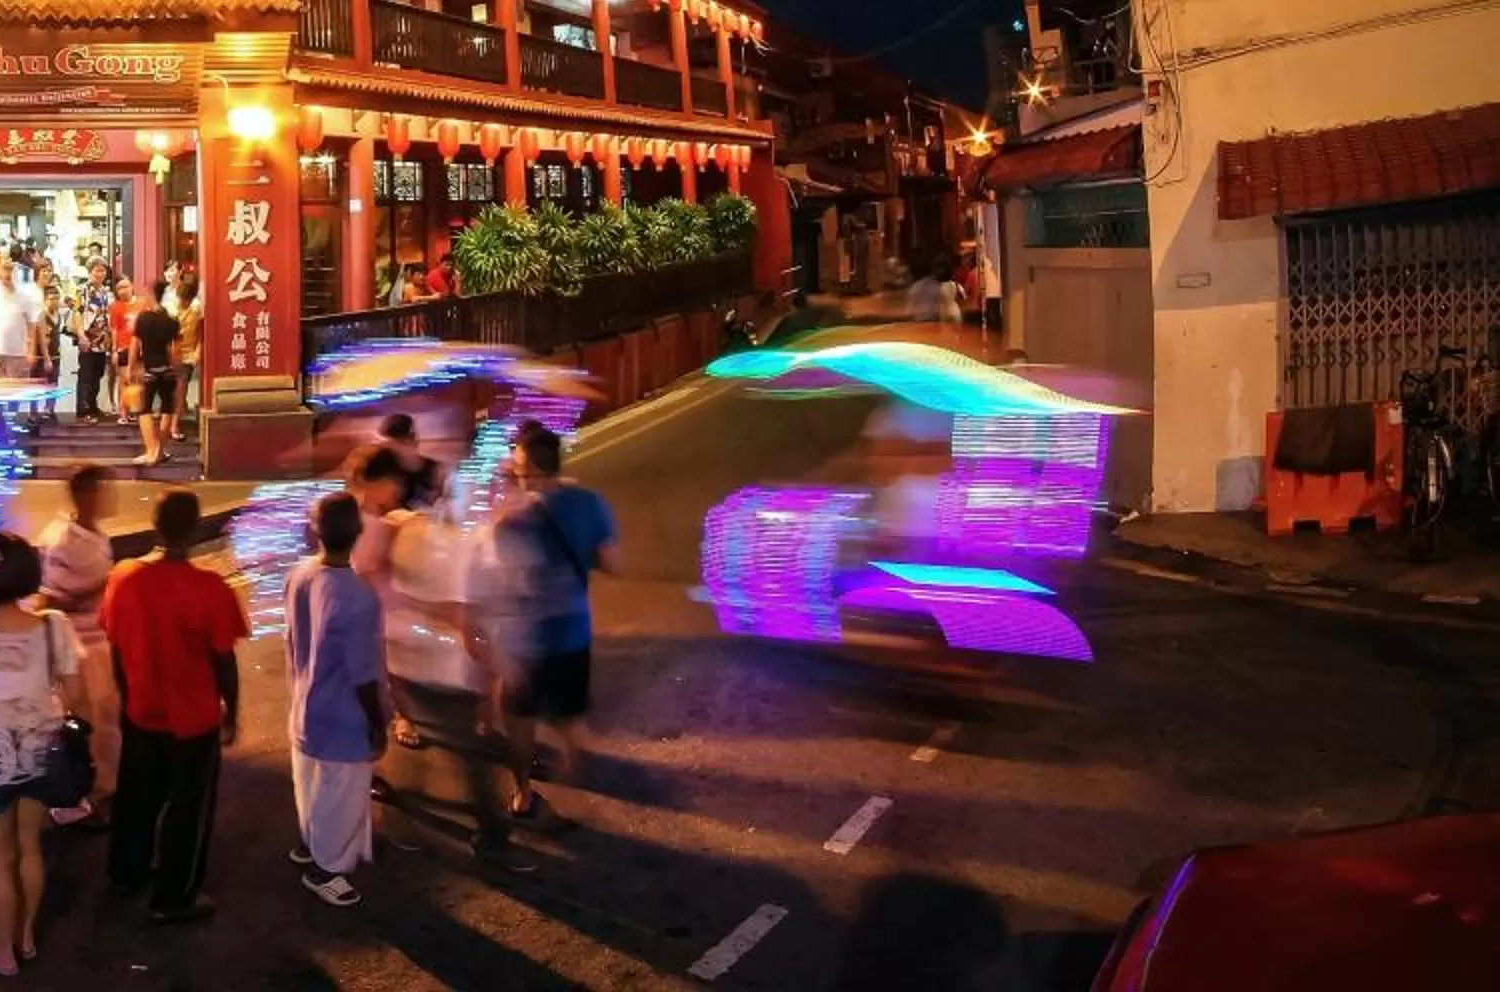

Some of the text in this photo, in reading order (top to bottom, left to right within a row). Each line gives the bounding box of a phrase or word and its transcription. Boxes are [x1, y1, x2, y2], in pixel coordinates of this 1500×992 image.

[55, 45, 183, 83] Gong
[225, 147, 271, 302] 三叔公
